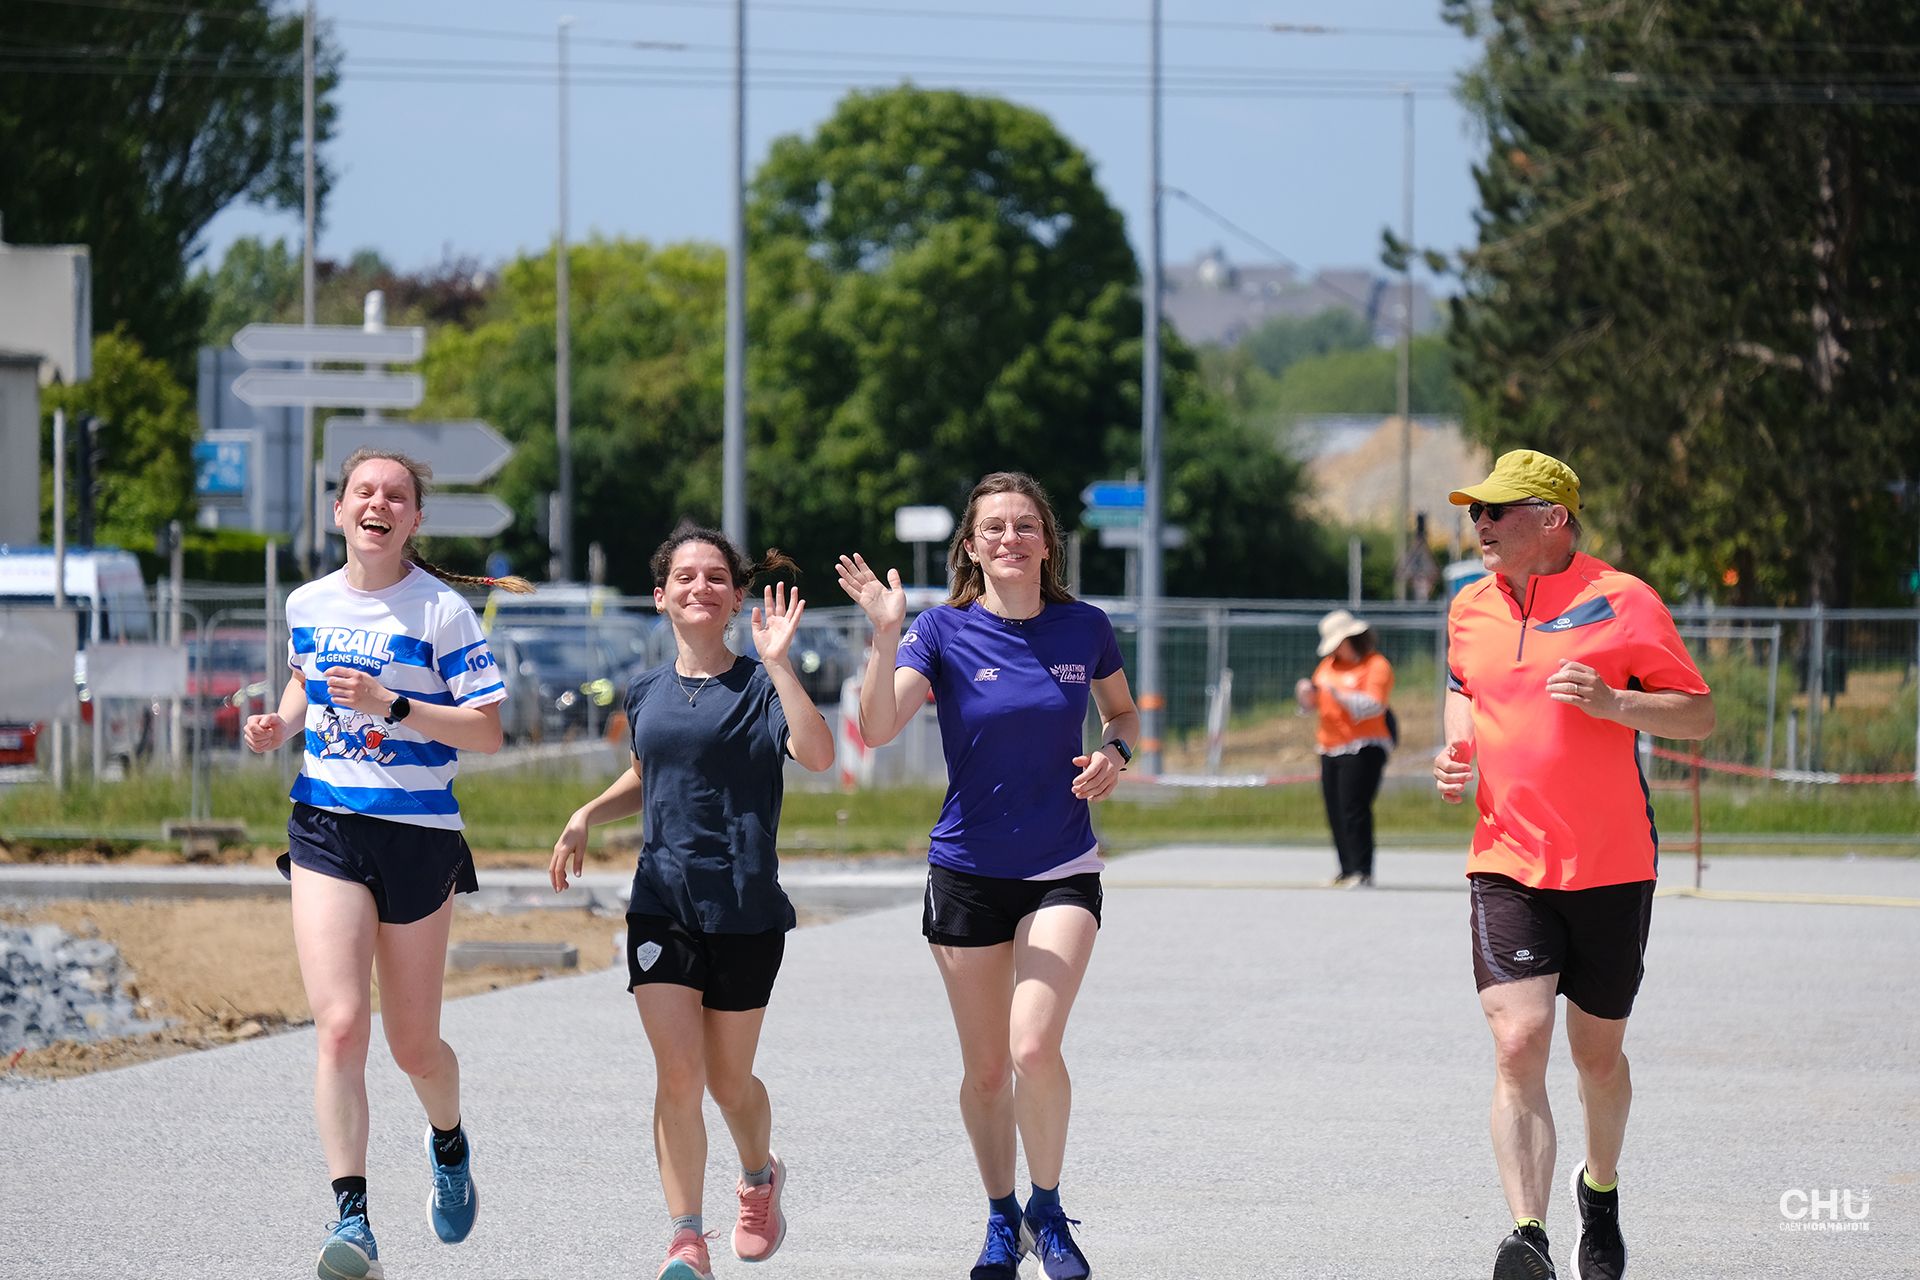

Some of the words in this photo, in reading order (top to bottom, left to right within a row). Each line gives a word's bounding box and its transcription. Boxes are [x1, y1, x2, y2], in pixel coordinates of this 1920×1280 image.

[317, 627, 390, 662] TRAIL
[326, 654, 352, 663] GENS
[353, 656, 381, 669] BONS
[1054, 664, 1086, 673] MARATHON
